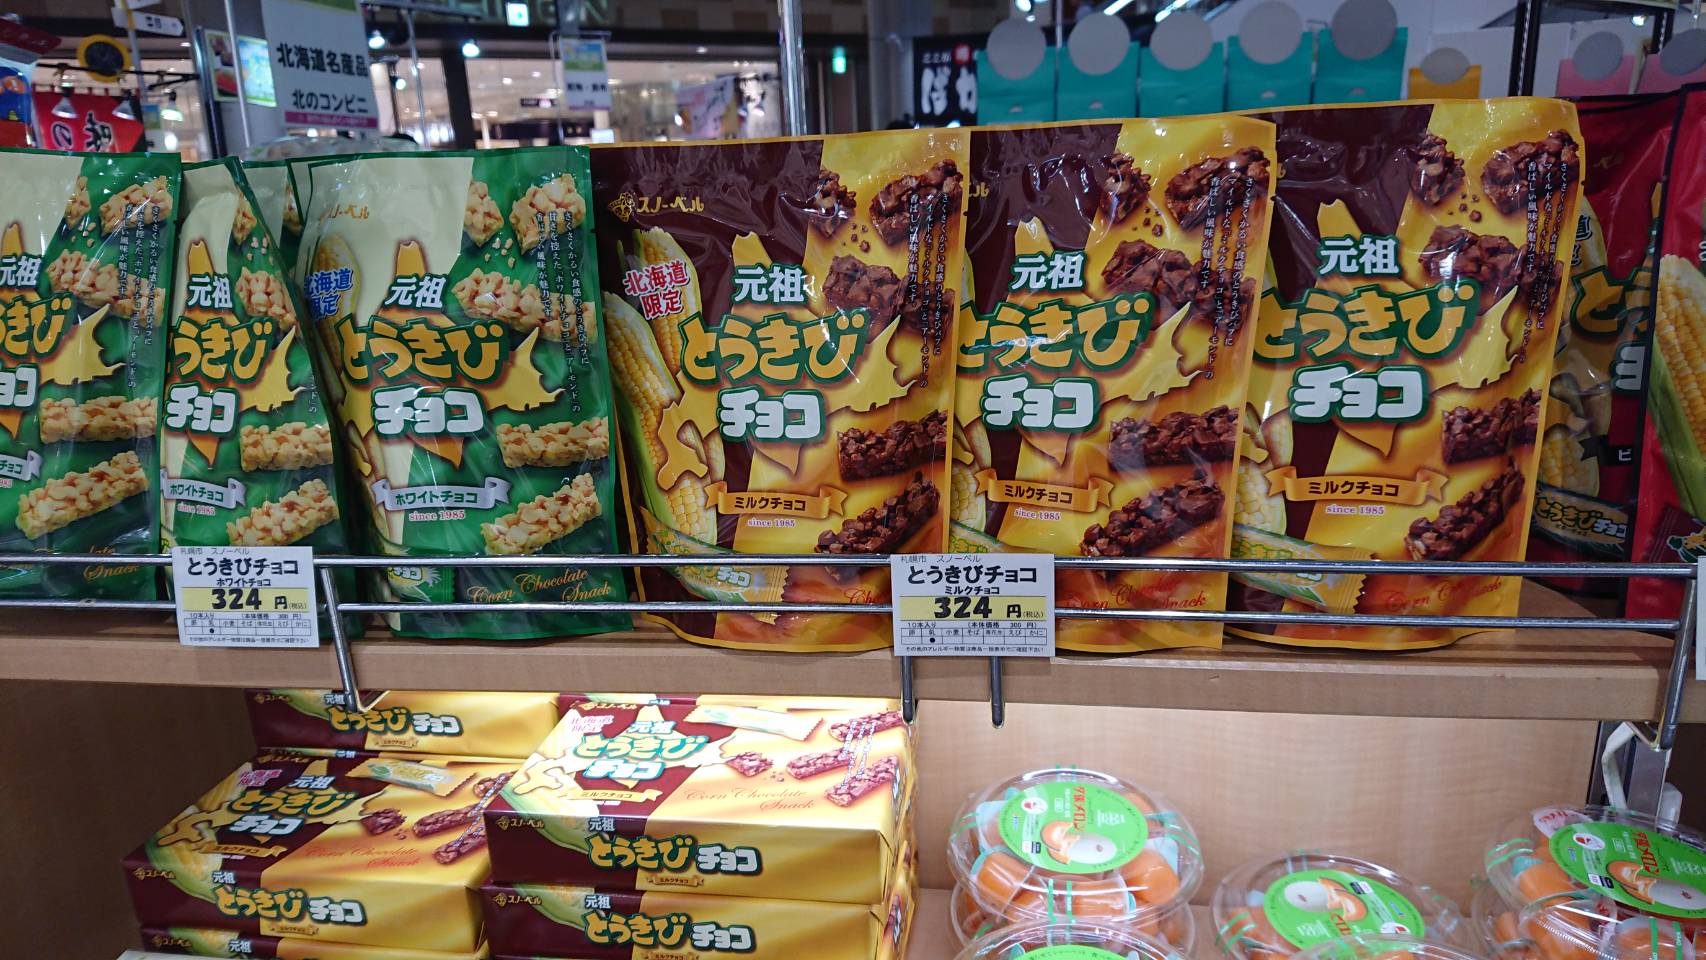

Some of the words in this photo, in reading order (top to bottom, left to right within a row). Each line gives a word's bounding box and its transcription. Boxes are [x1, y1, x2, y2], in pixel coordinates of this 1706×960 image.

[276, 42, 369, 77] 北海道名産品
[291, 87, 369, 113] 北のコンビニ
[637, 195, 705, 214] スノーベル
[1319, 239, 1400, 275] 元祖
[0, 256, 40, 287] 元祖
[624, 262, 689, 296] 北海道
[1011, 253, 1086, 290] 元祖
[188, 276, 233, 309] 元祖
[385, 277, 446, 309] 元祖
[734, 267, 806, 303] 元祖
[641, 289, 684, 319] 限定
[1255, 284, 1475, 359] とうきび
[957, 298, 1151, 369] とうきび
[338, 323, 504, 382] とうきび
[683, 314, 866, 381] とうきび
[983, 376, 1094, 429] チョコ
[1294, 367, 1424, 419] チョコ
[166, 385, 236, 433] チョコ
[374, 387, 484, 434] チョコ
[720, 389, 822, 439] チョコ
[169, 482, 224, 503] ホワイトチョコ
[394, 490, 479, 507] ホワイトチョコ
[1004, 484, 1073, 505] ミルクチョコ
[1307, 480, 1400, 498] ミルクチョコ
[734, 496, 806, 512] ミルクチョコ
[1014, 508, 1036, 521] since
[1037, 511, 1060, 521] 1985
[1326, 504, 1356, 515] since
[1359, 505, 1385, 516] 1985
[408, 510, 437, 522] since
[439, 510, 466, 521] 1985
[747, 517, 772, 528] since
[774, 518, 797, 528] 1985
[212, 547, 250, 555] スノーベル
[936, 554, 981, 563] スノーベル
[187, 557, 299, 577] とうきびチョコ
[908, 565, 1037, 584] とうきびチョコ
[216, 578, 271, 587] ホワイトチョコ
[513, 567, 589, 594] Chocolate
[945, 586, 1000, 595] ミルクチョコ
[211, 588, 262, 610] 324
[274, 595, 288, 610] 円
[561, 581, 612, 603] Snack
[934, 596, 992, 619] 324
[1006, 604, 1022, 619] 円
[324, 694, 346, 705] 元祖
[413, 714, 460, 733] チョコ
[575, 734, 709, 761] とうきび
[288, 776, 336, 789] 元祖
[231, 791, 355, 816] とうきび
[229, 815, 303, 835] チョコ
[510, 818, 545, 829] スノーベル
[589, 818, 616, 832] 元祖
[589, 834, 693, 869] とうきび
[697, 845, 758, 872] チョコ
[211, 871, 236, 884] 元祖
[214, 886, 304, 919] とうきび
[308, 897, 363, 923] チョコ
[507, 894, 542, 905] スノーベル
[584, 895, 611, 909] 元祖
[585, 911, 688, 945] とうきび
[692, 924, 752, 950] チョコ
[228, 940, 252, 953] 元祖
